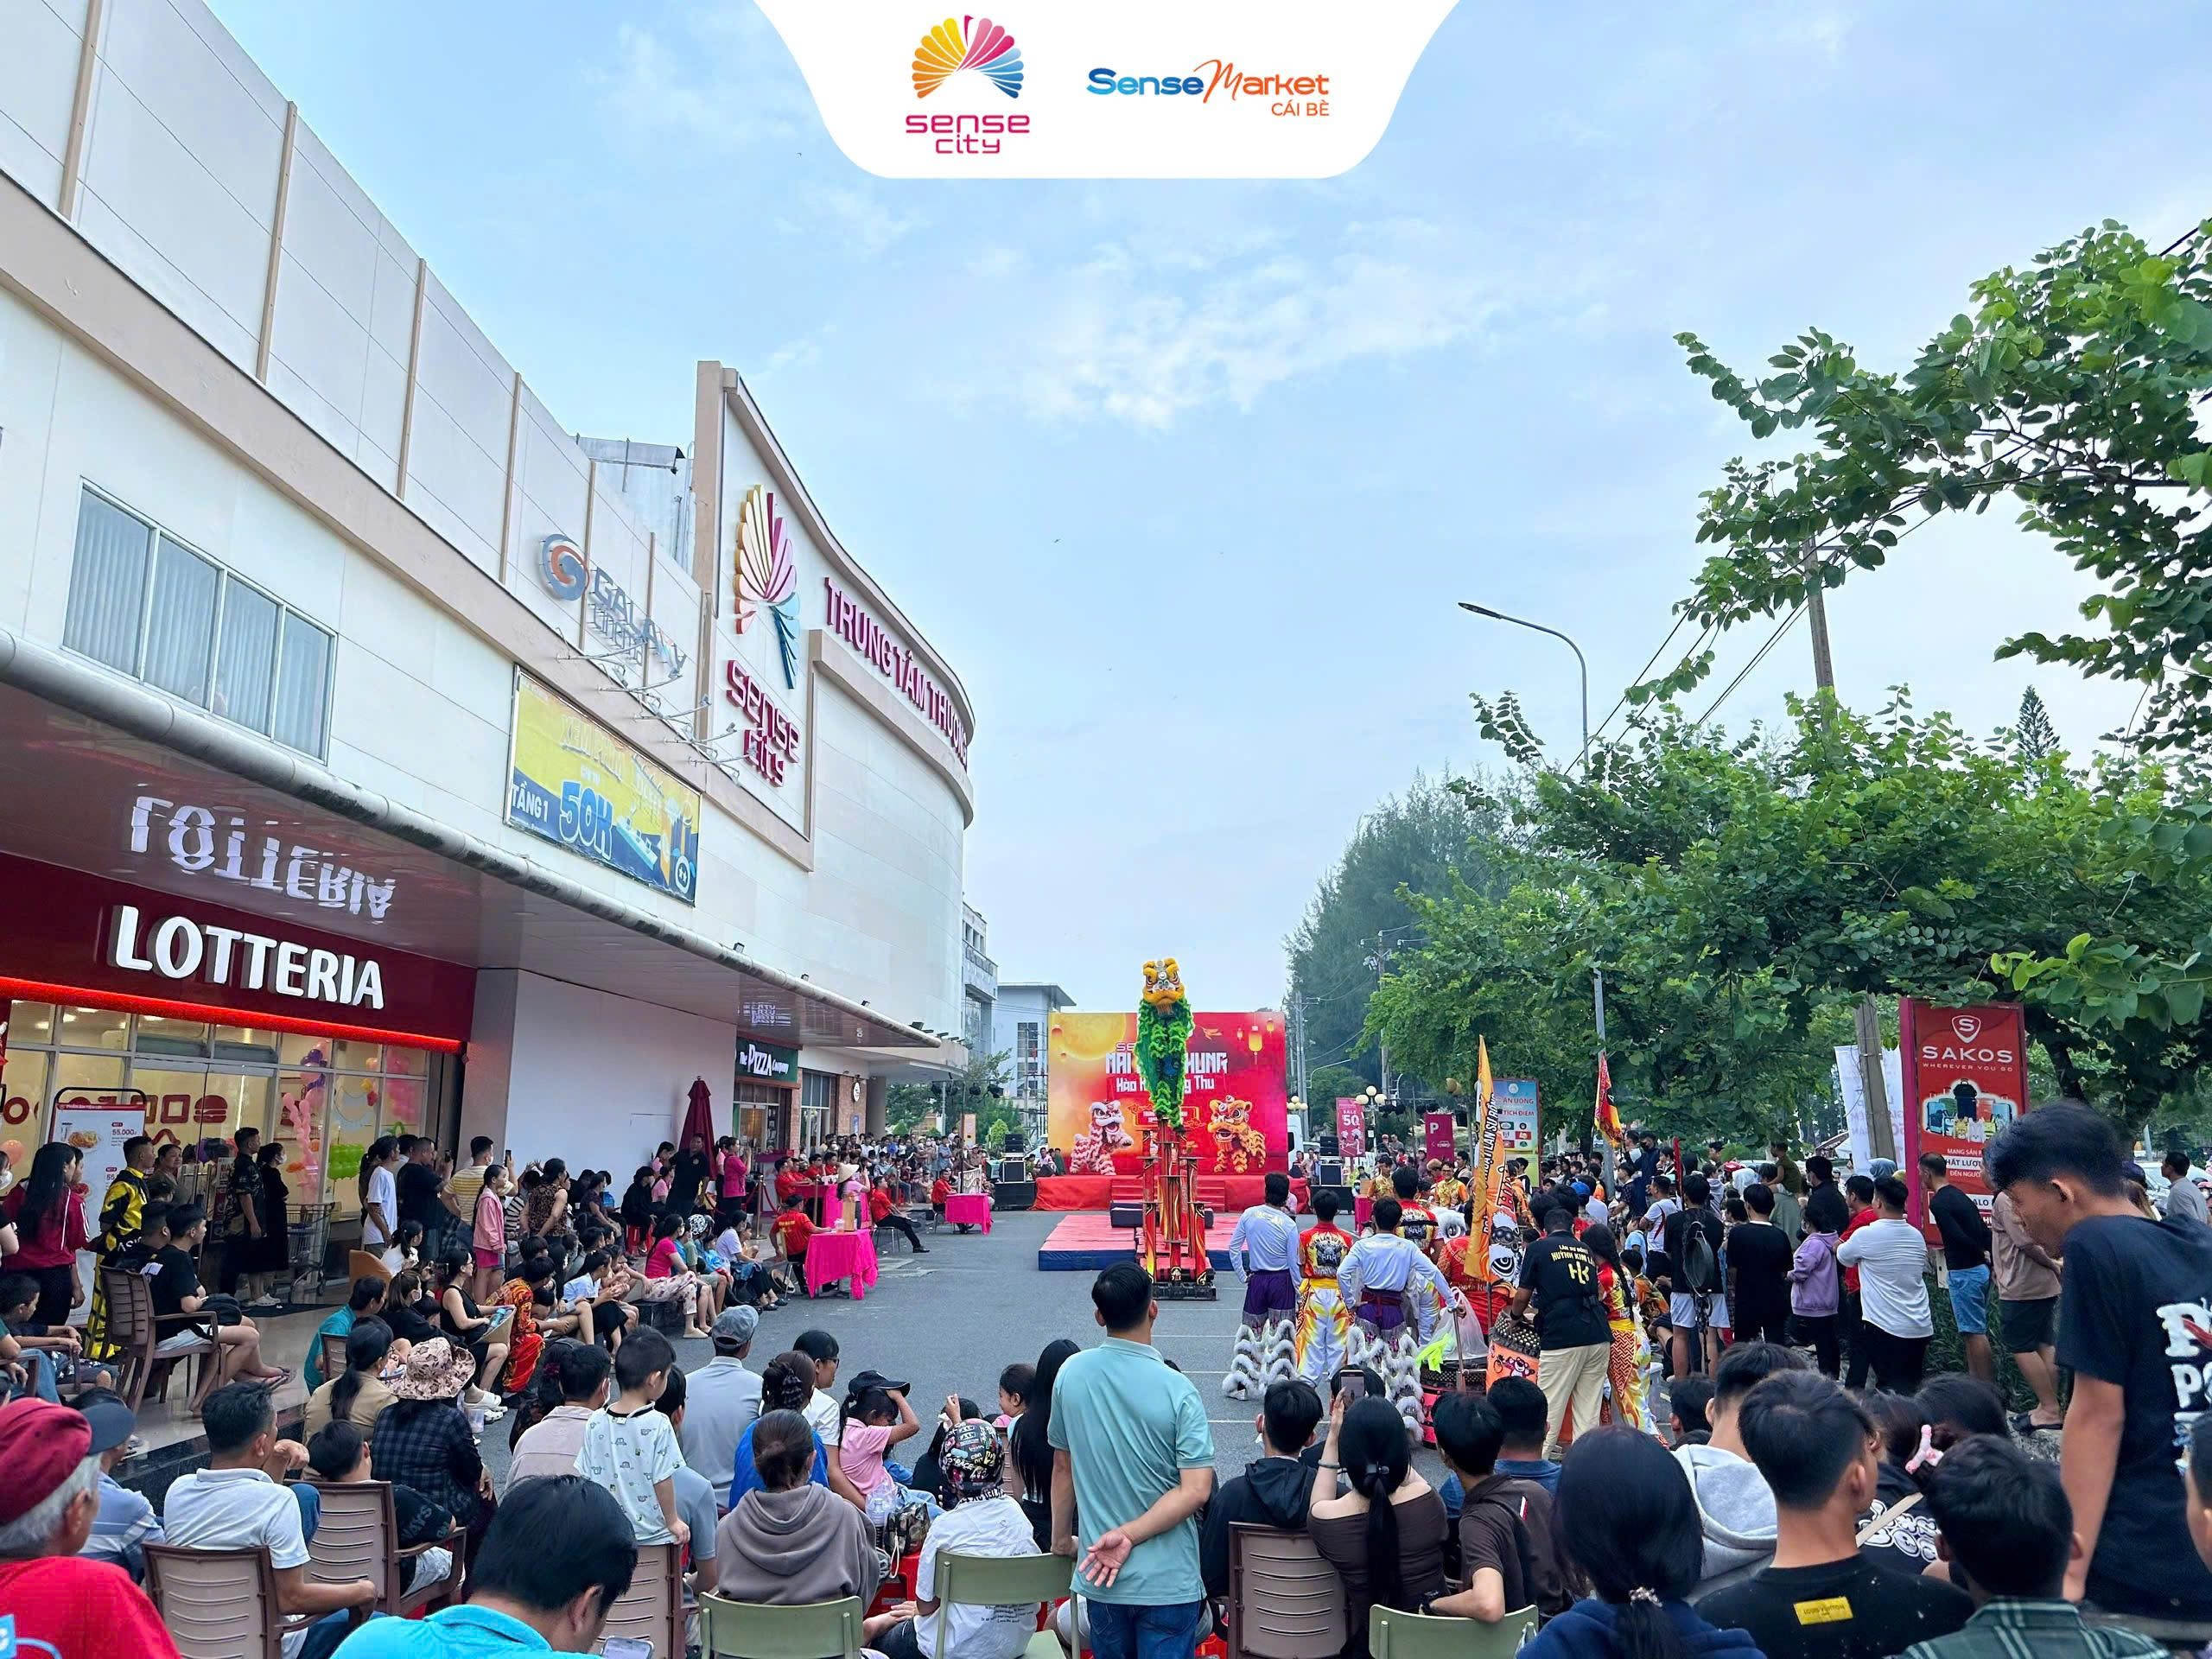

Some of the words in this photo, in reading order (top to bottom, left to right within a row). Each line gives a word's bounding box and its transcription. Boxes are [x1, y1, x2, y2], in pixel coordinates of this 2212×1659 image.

[824, 576, 892, 677] TRUNG
[893, 647, 926, 712] TÂM
[512, 780, 542, 819] TẦNG
[543, 798, 549, 823] 1
[115, 904, 385, 1009] LOTTERIA
[747, 1044, 772, 1076] PIZZA
[1922, 1046, 2013, 1064] SAKOS
[1194, 1075, 1215, 1090] Thu
[1429, 1122, 1440, 1135] P
